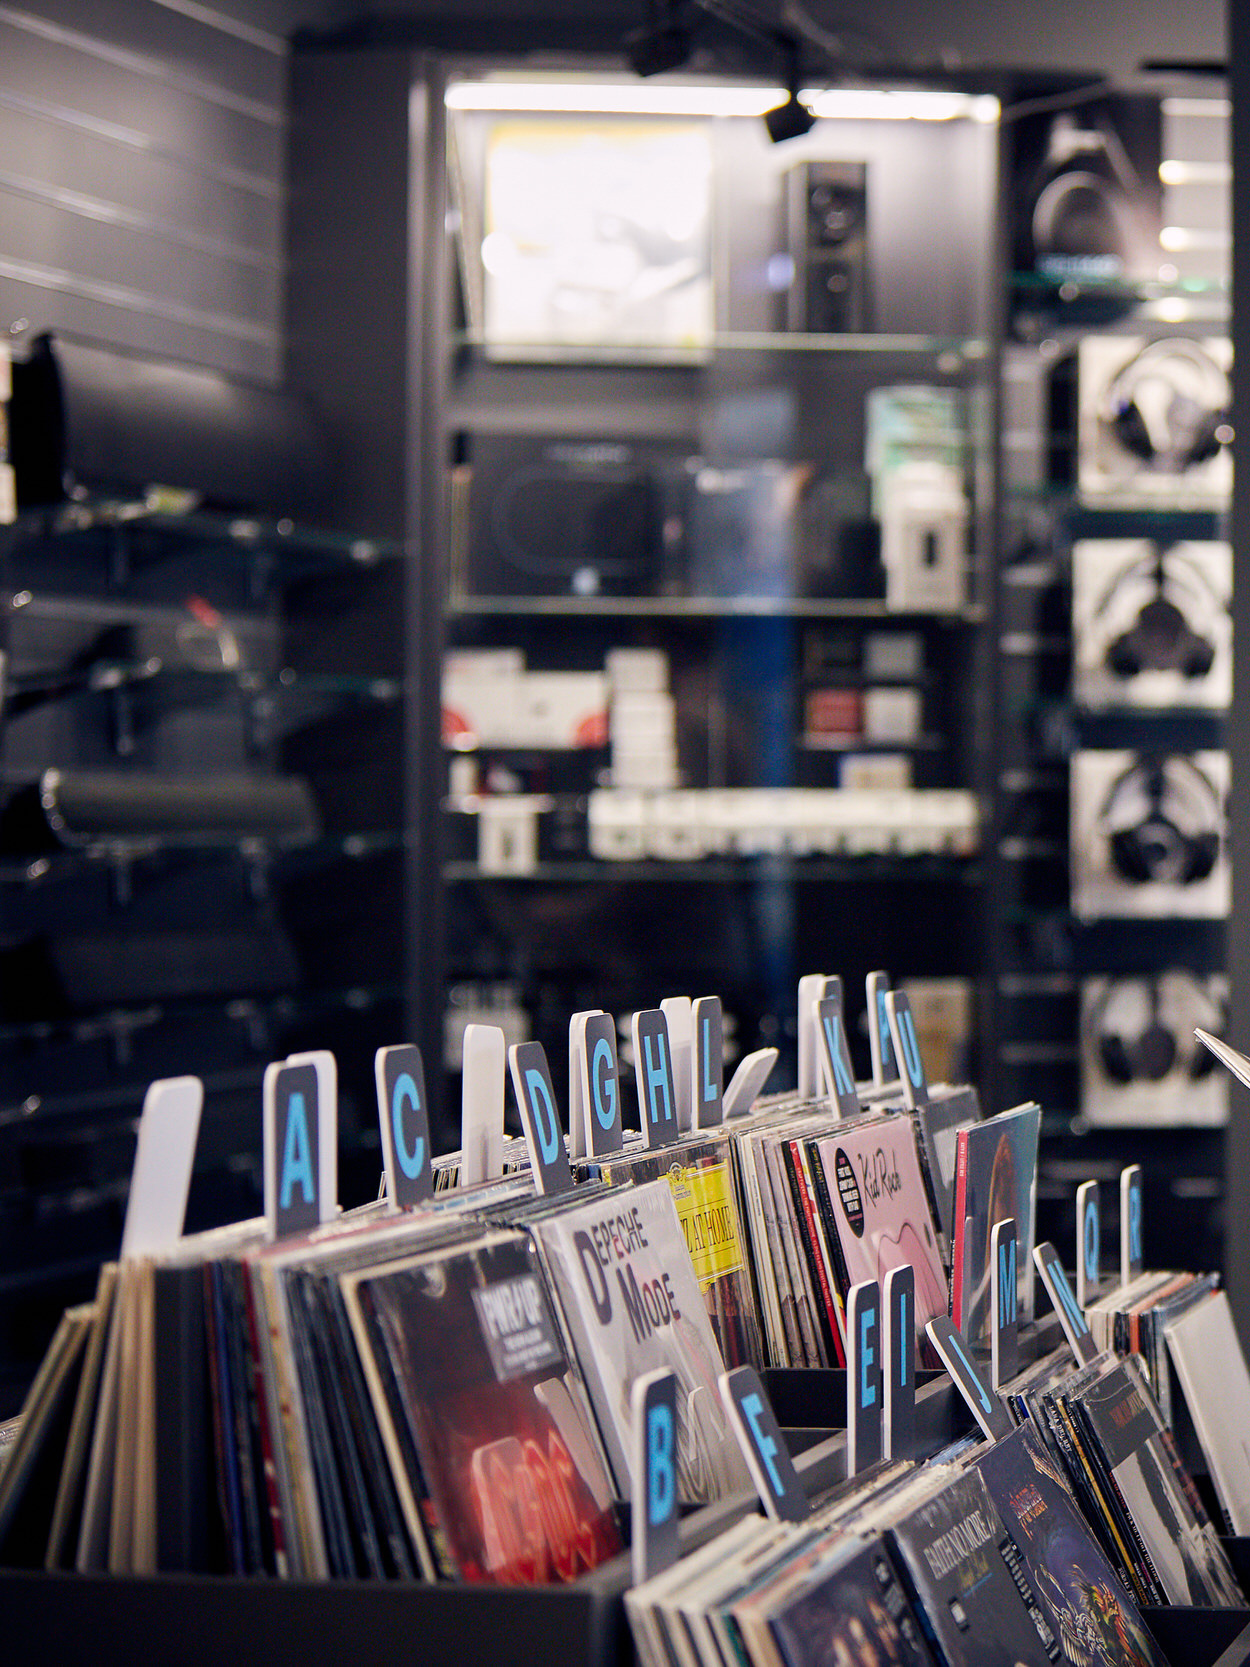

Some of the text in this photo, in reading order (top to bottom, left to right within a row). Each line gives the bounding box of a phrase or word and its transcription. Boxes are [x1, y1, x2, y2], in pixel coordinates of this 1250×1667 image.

[591, 1038, 617, 1131] G
[643, 1033, 673, 1124] H
[703, 1018, 718, 1102] L
[822, 1015, 855, 1096] K
[896, 1009, 923, 1089] U
[280, 1092, 316, 1209] A
[392, 1073, 425, 1181] C
[524, 1068, 559, 1166] D
[573, 1207, 649, 1326] DEPECHE
[692, 1213, 706, 1252] AT
[703, 1206, 735, 1247] HOME
[615, 1262, 682, 1345] MODE
[1000, 1239, 1017, 1330] M
[1046, 1259, 1088, 1339] N
[860, 1307, 876, 1409] E
[948, 1334, 992, 1414] J
[740, 1392, 785, 1497] F
[1048, 1404, 1062, 1425] LANA
[646, 1403, 675, 1527] B
